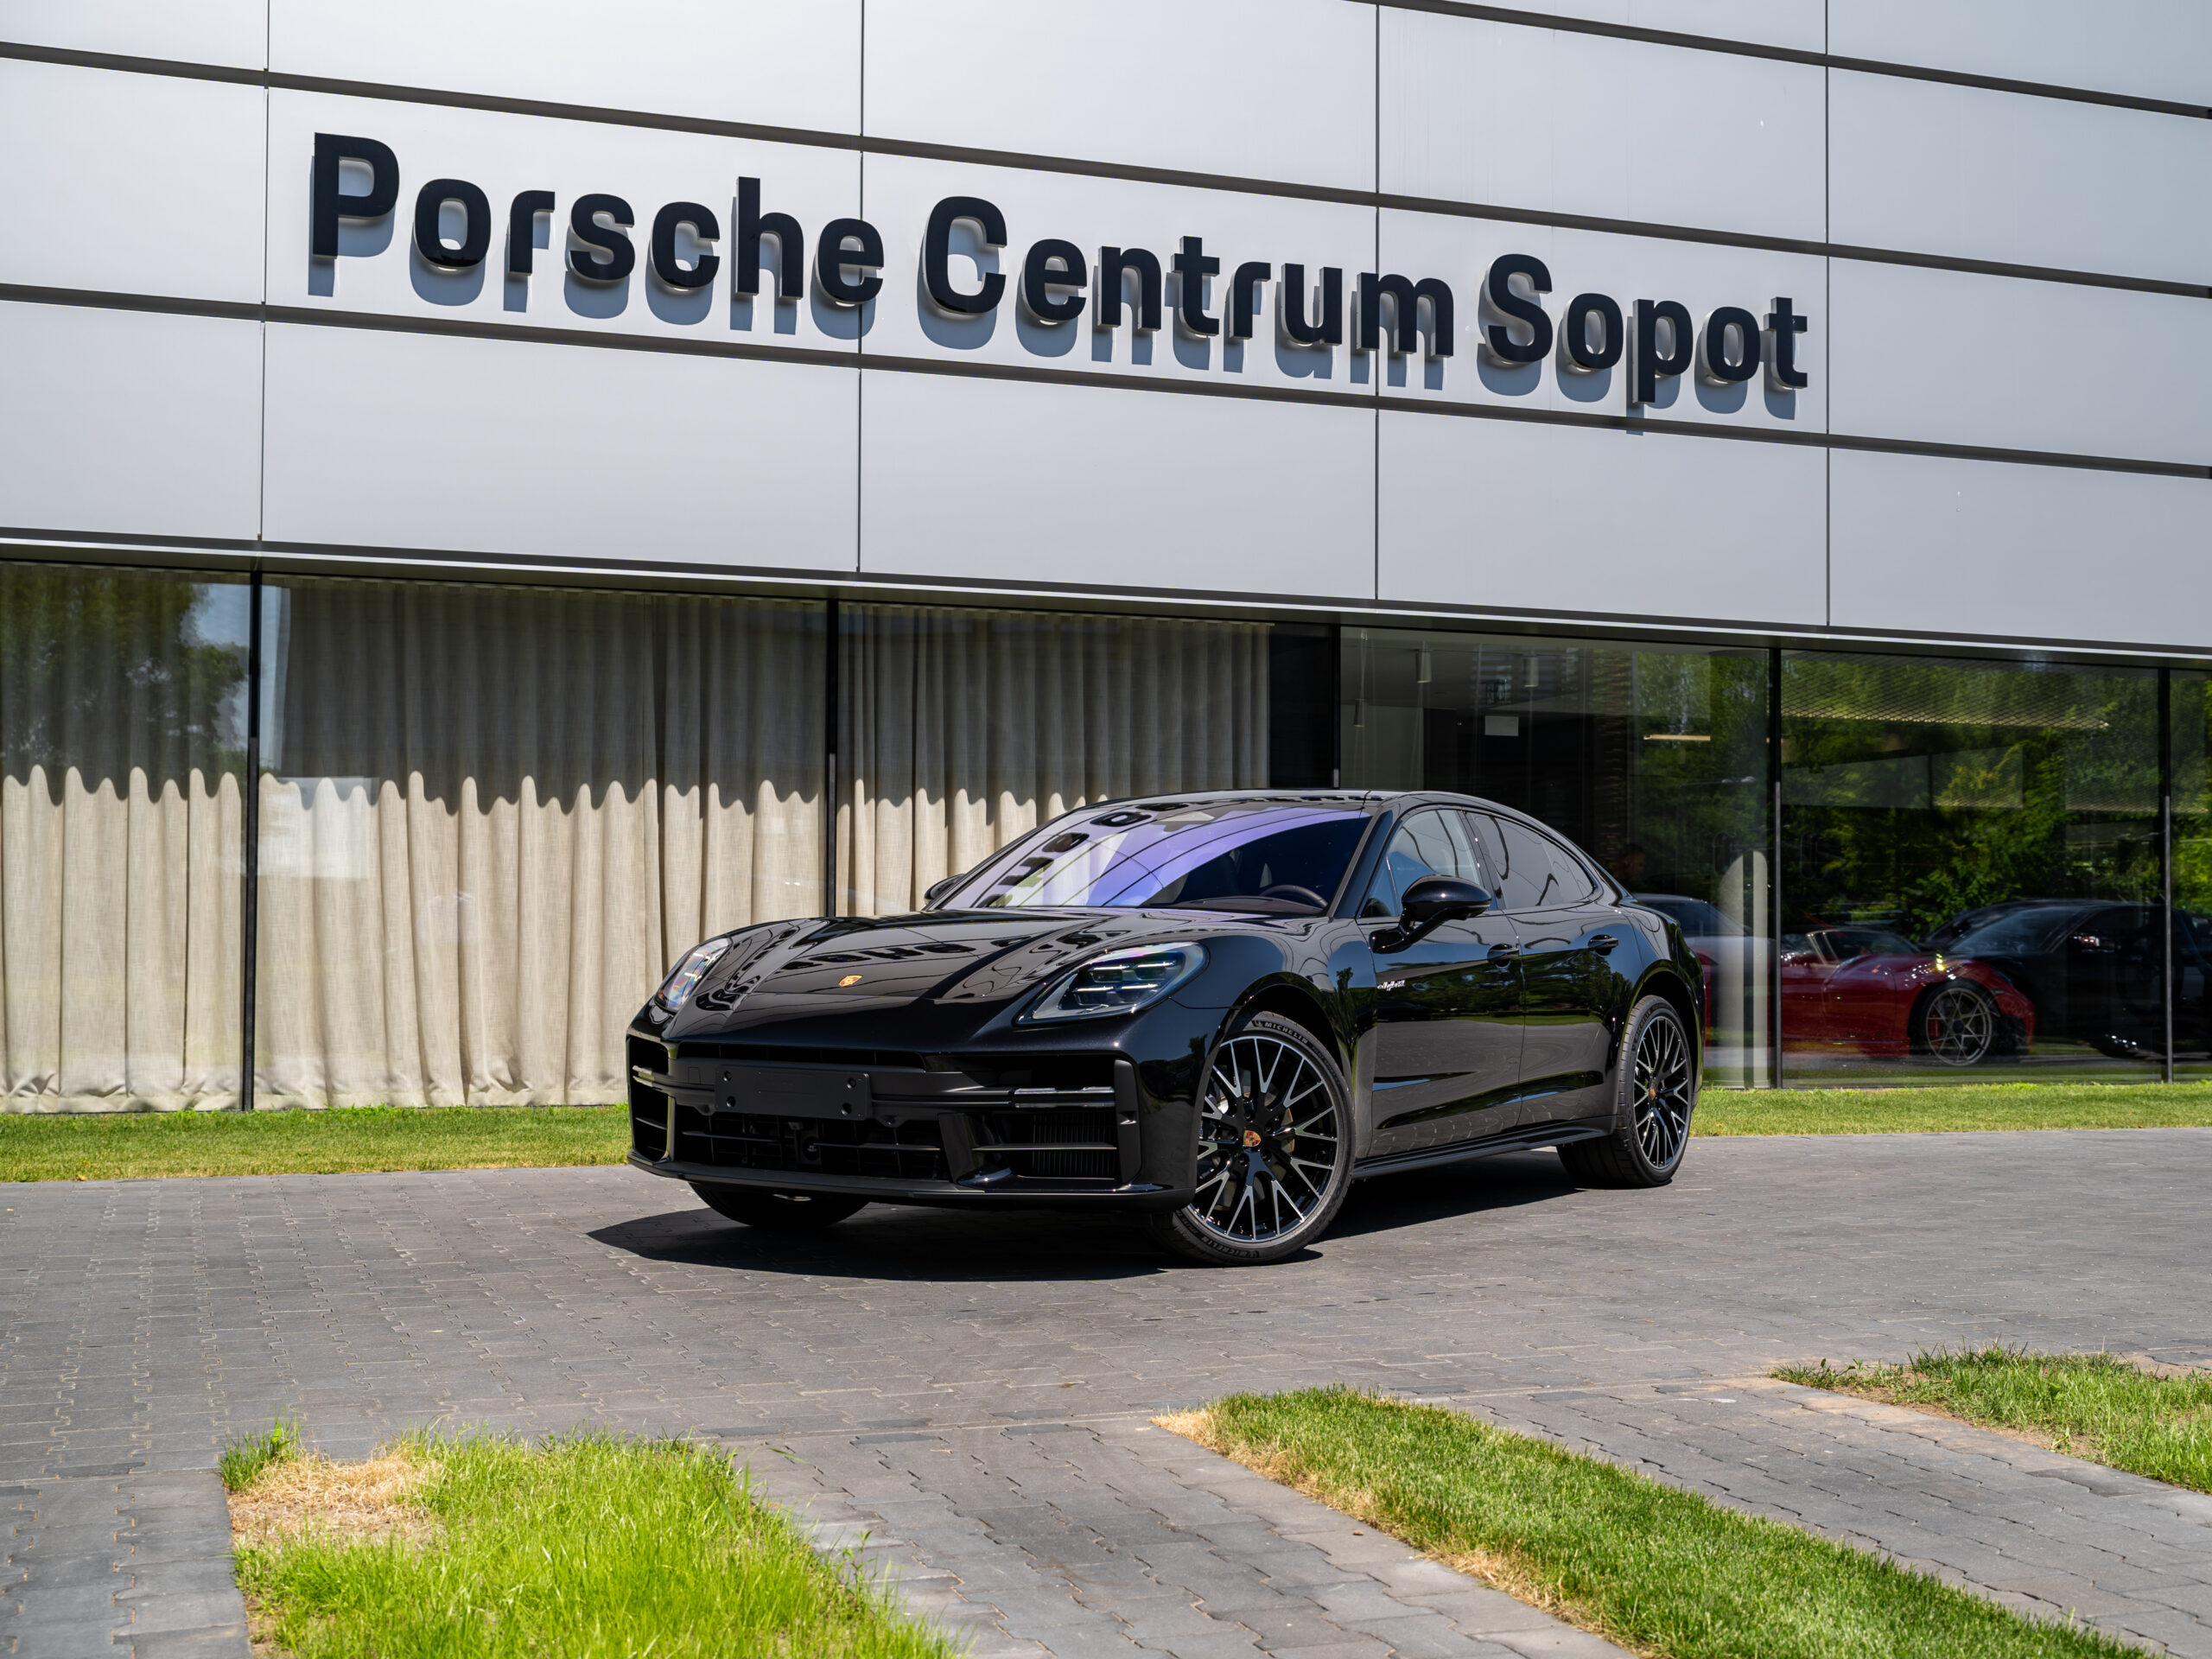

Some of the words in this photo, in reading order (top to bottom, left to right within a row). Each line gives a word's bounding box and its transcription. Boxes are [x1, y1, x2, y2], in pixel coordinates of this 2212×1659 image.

[311, 132, 885, 308] Porsche
[925, 195, 1454, 358] Centrum
[1485, 252, 1808, 404] Sopot
[1264, 1021, 1308, 1045] MICHELIN
[1200, 1236, 1248, 1257] MICHELIN
